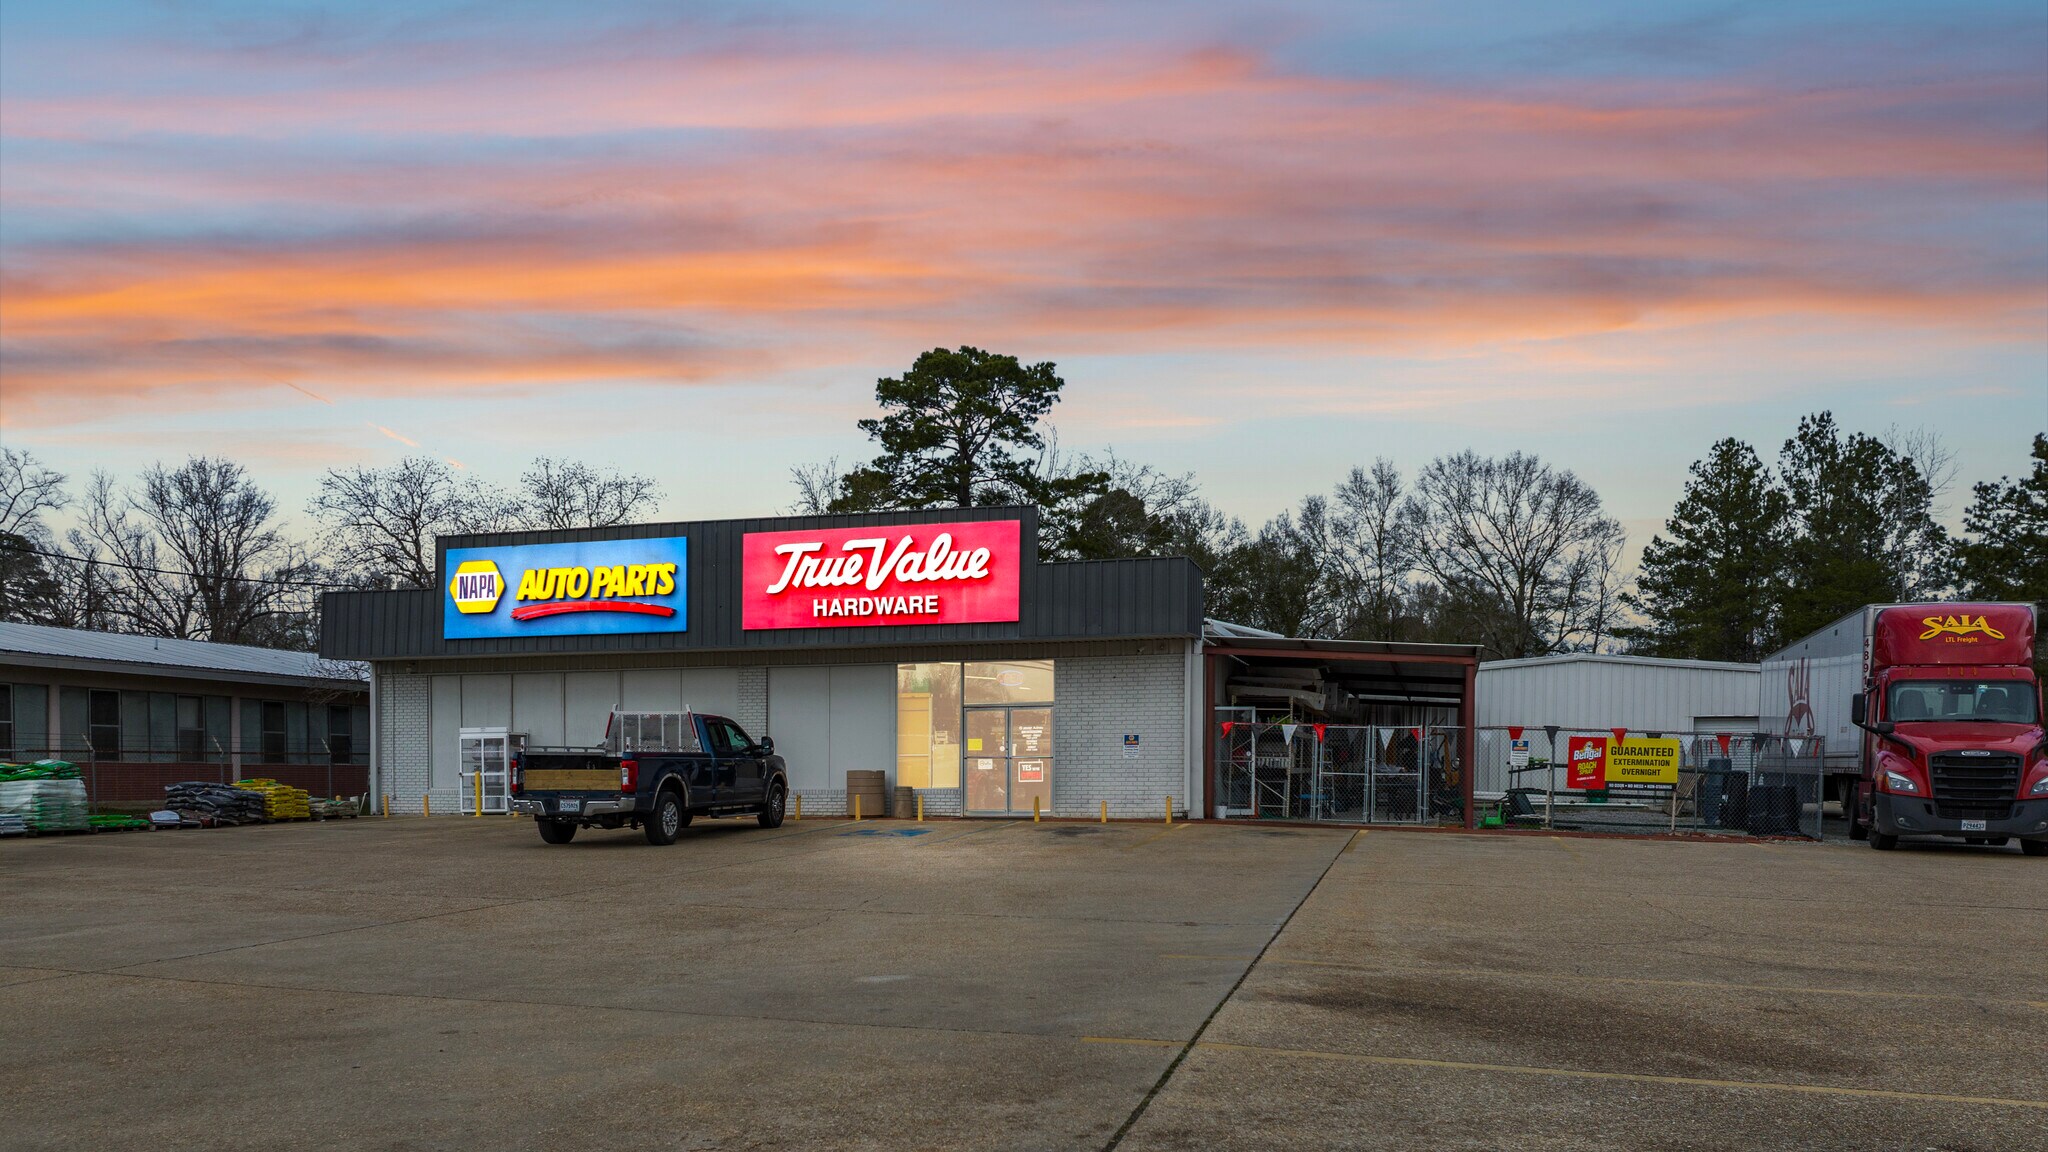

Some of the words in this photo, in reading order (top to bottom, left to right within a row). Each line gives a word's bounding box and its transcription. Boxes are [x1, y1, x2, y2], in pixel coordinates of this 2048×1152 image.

[766, 542, 864, 594] True
[842, 533, 990, 591] Value
[459, 575, 495, 599] NAPA
[516, 566, 589, 601] AUTO
[590, 562, 677, 598] PARTS
[813, 595, 938, 616] HARDWARE
[1919, 615, 2005, 640] SAIA
[1573, 747, 1602, 760] Bengal
[1611, 746, 1674, 757] GUARANTEED
[1613, 758, 1670, 766] EXTERMINATION
[1621, 768, 1661, 776] OVERNIGHT
